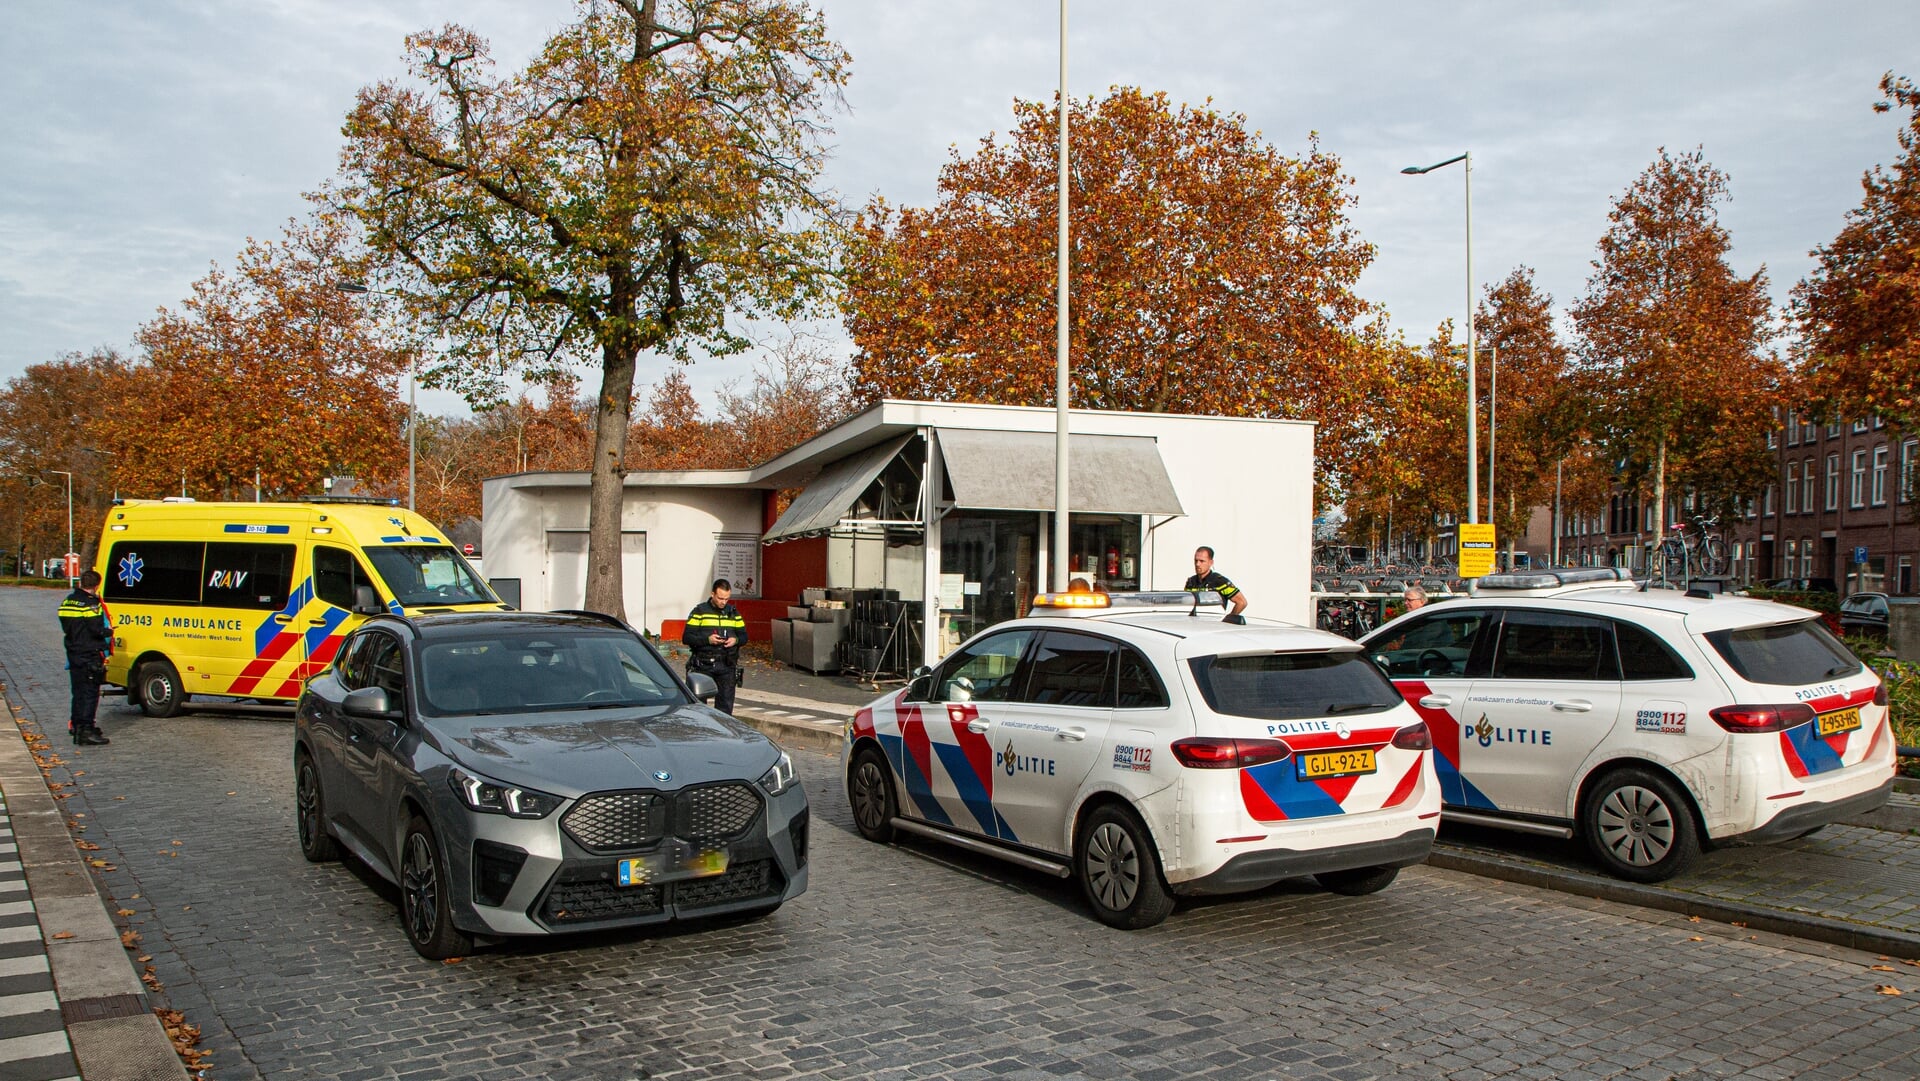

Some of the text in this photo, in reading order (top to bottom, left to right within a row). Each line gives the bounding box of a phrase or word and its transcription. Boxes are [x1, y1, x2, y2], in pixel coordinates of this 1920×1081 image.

[118, 614, 152, 626] 20-143
[163, 616, 242, 631] AMBULANCE
[1795, 685, 1837, 700] POLITIE
[1636, 718, 1660, 726] 8844
[1637, 711, 1661, 719] 0900
[1662, 712, 1686, 725] 112
[1821, 712, 1857, 731] Z-953-HS
[1267, 721, 1330, 735] POLITIE
[1661, 726, 1685, 734] spoed
[1464, 725, 1551, 747] POLITIE
[1115, 745, 1134, 754] 0900
[1134, 748, 1152, 762] 112
[997, 752, 1055, 776] POLITIE
[1114, 754, 1131, 763] 8844
[1311, 753, 1368, 773] GJL-92-Z
